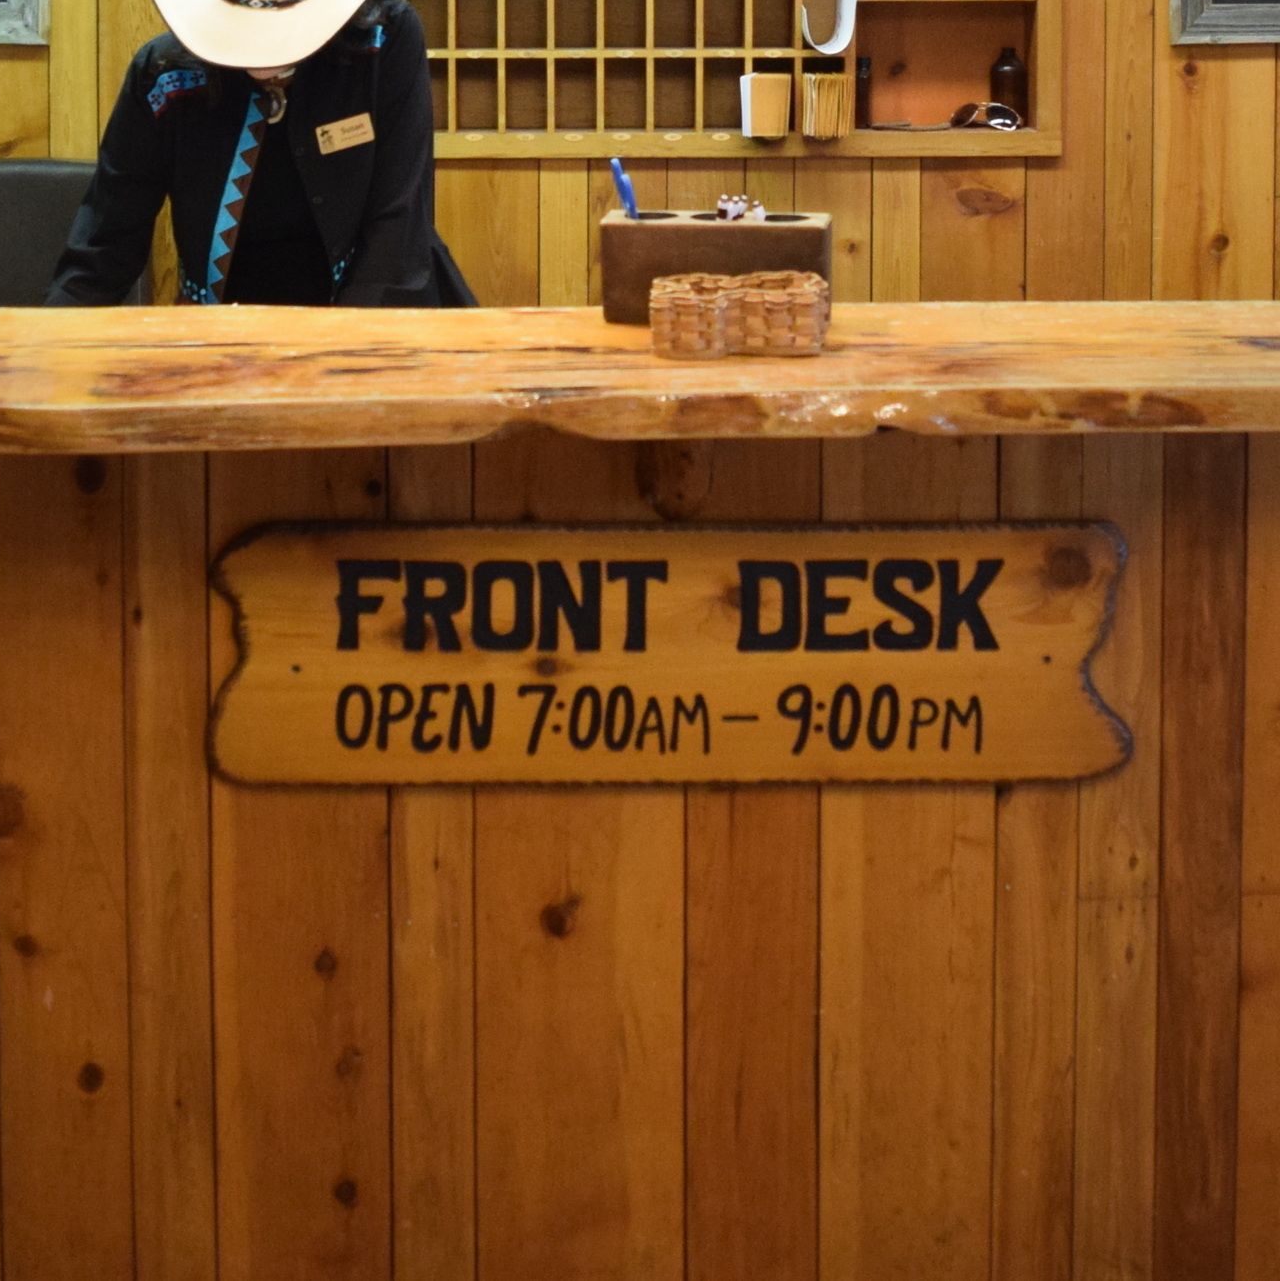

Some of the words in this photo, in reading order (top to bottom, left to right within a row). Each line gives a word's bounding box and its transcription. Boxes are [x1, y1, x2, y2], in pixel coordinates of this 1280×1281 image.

[336, 559, 668, 652] FRONT
[736, 559, 1005, 652] DESK
[335, 682, 495, 752] OPEN
